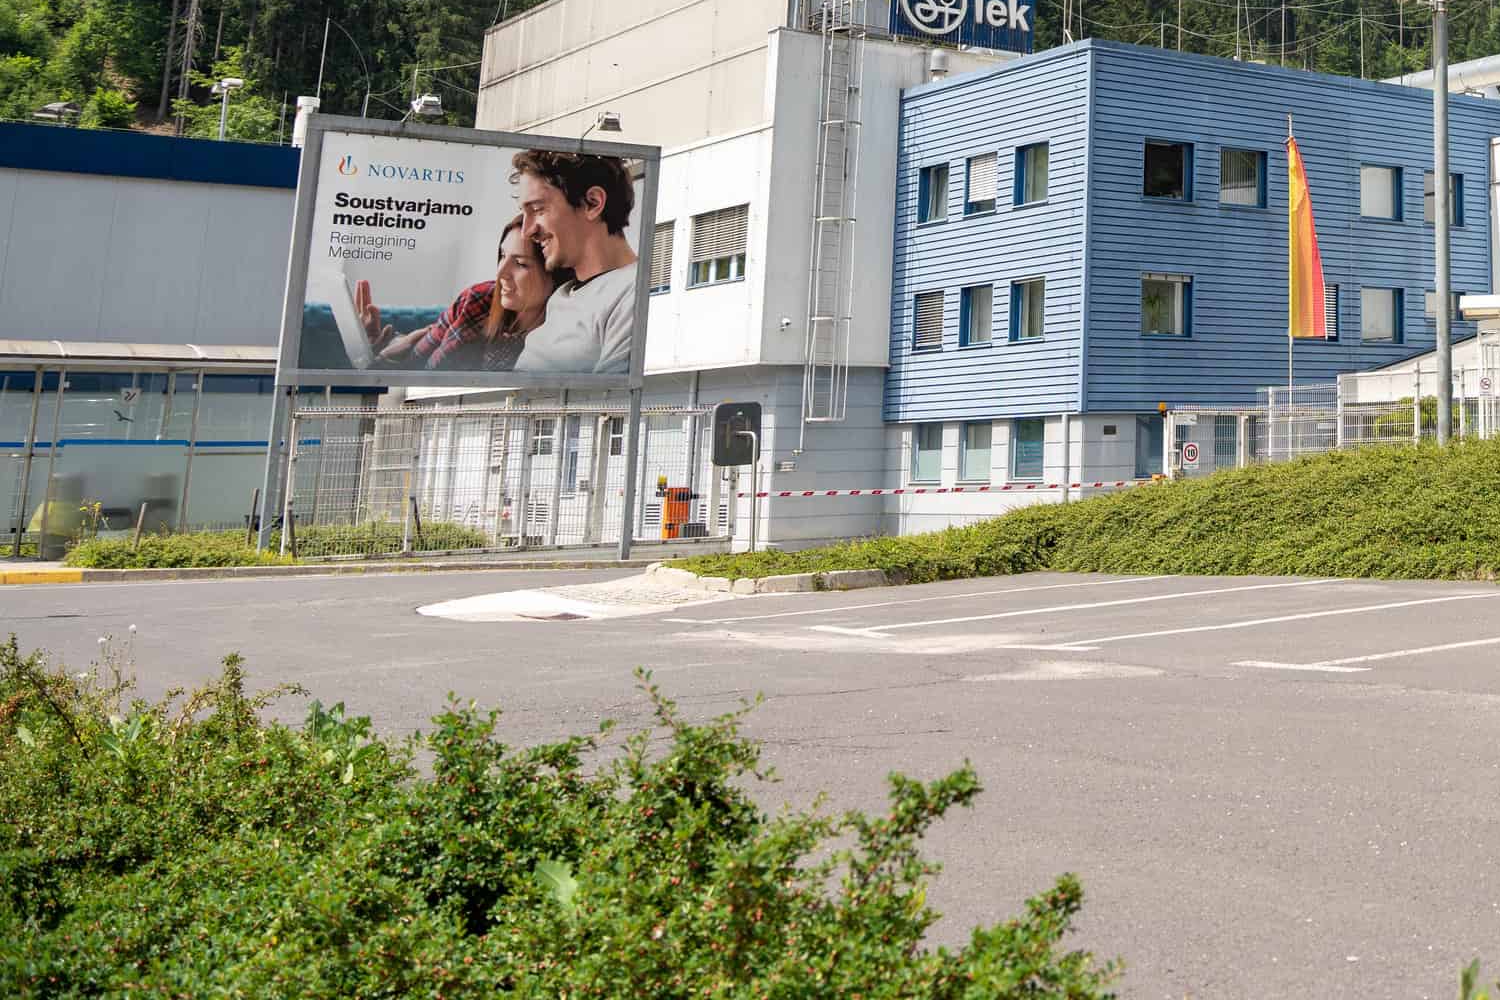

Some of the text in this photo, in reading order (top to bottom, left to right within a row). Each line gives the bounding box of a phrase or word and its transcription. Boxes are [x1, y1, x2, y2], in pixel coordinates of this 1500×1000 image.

[368, 164, 465, 184] NOVARTIS
[334, 192, 473, 216] Soustvarjamo
[332, 212, 426, 230] medicino
[330, 231, 416, 250] Reimagining
[328, 246, 393, 261] Medicine
